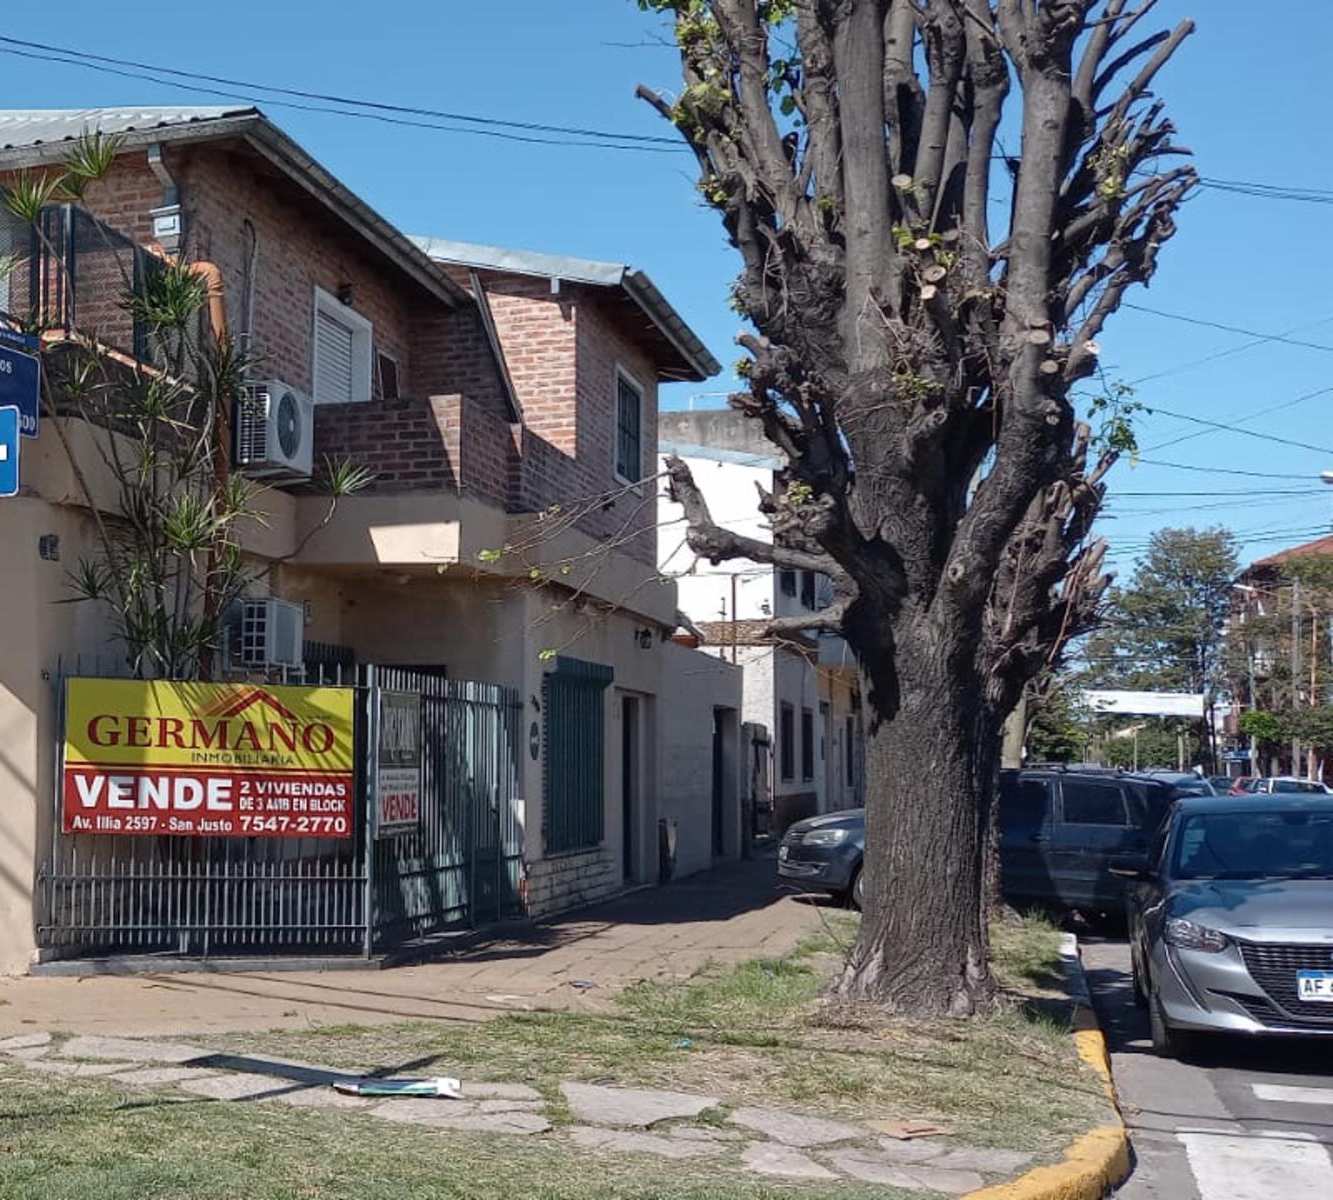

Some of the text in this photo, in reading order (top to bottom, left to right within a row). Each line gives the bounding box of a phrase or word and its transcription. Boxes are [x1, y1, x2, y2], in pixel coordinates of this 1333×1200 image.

[87, 714, 335, 754] GERMANO
[191, 753, 295, 765] INMOBILIARIA
[74, 774, 233, 811] VENDE
[240, 781, 346, 796] 2 VIVIENDAS
[239, 797, 254, 810] DE
[292, 799, 307, 811] EN
[310, 799, 346, 812] BLOCK
[382, 793, 417, 821] VENDE
[72, 815, 92, 829] Av.
[96, 816, 121, 829] Illia
[125, 817, 157, 830] 2597
[169, 817, 194, 831] San
[197, 818, 233, 832] Justo
[239, 816, 347, 833] 7547-2770
[1304, 979, 1323, 993] AF
